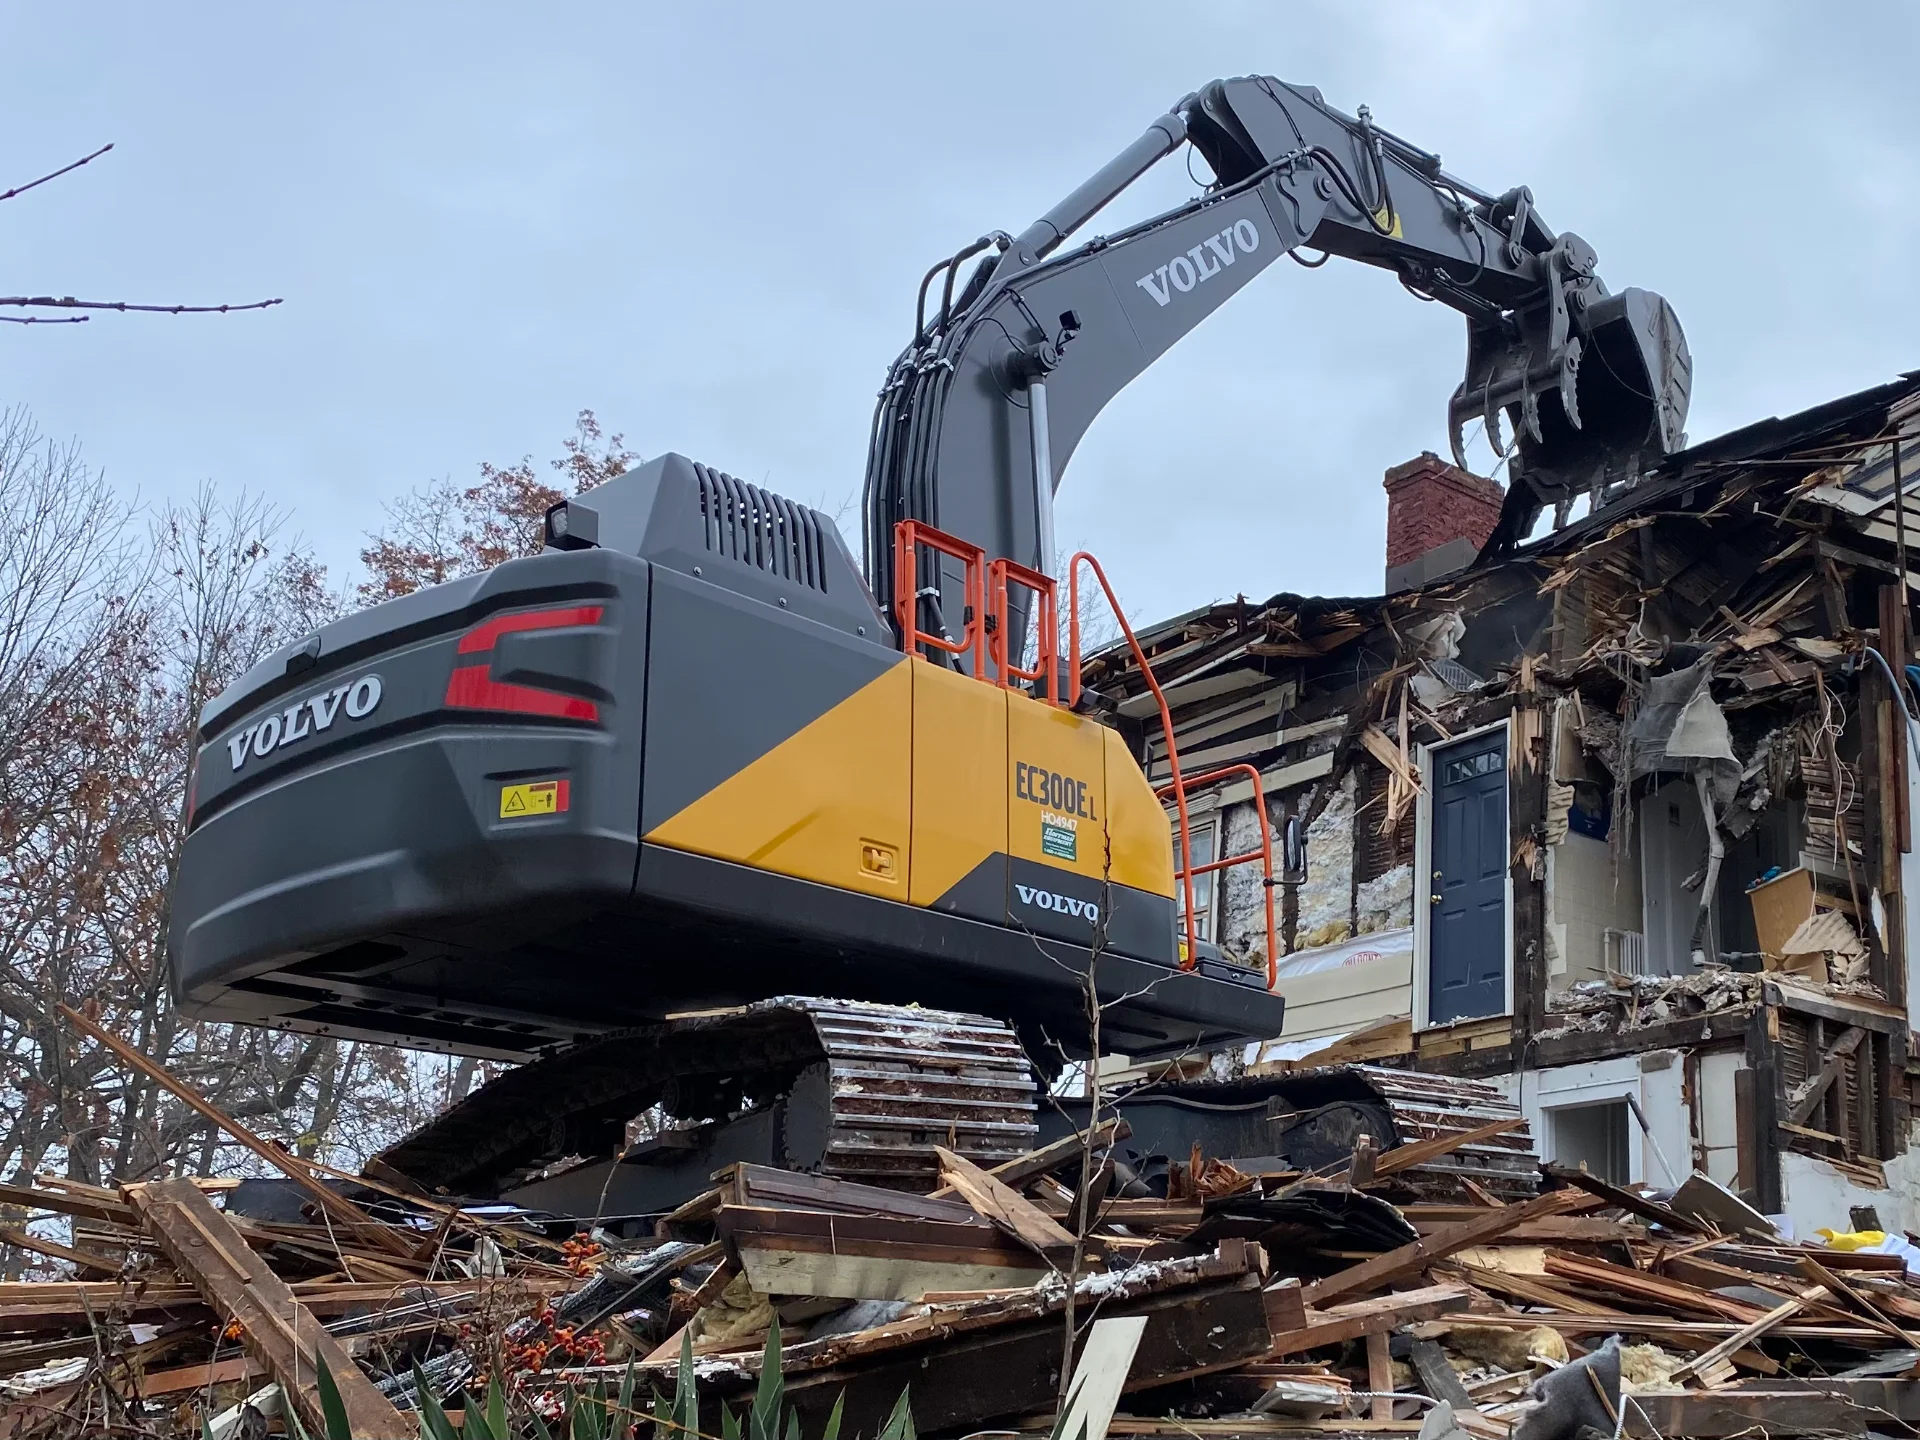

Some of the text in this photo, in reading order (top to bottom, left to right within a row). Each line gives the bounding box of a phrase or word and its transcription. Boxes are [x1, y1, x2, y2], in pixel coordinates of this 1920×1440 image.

[1136, 218, 1260, 307] VOLVO
[227, 675, 382, 770] VOLVO
[1015, 884, 1099, 922] VOLVO
